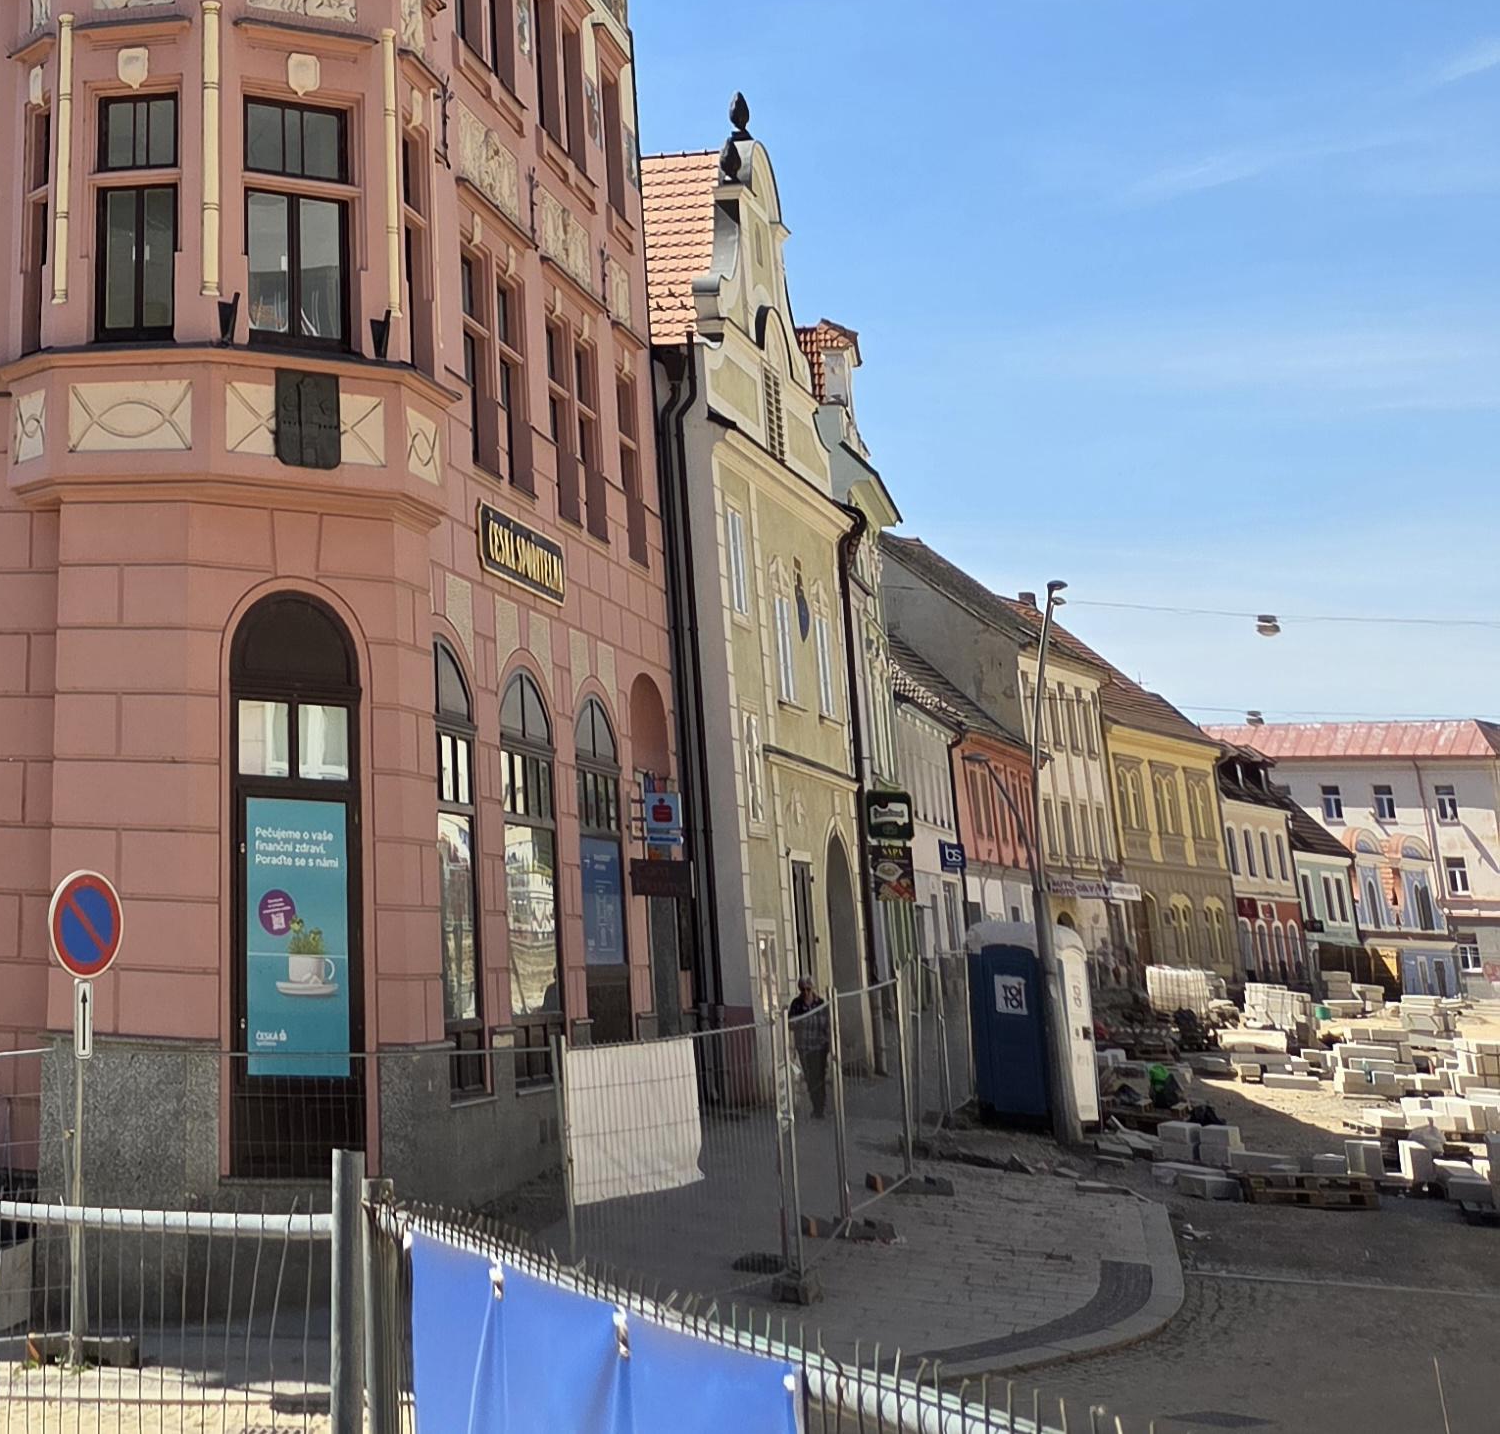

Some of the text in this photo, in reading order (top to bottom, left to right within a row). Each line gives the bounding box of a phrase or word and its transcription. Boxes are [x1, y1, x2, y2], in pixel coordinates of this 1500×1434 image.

[488, 509, 517, 571] ČESKÁ
[255, 826, 334, 841] Pečujeme o vaše
[255, 840, 326, 854] finanční zdraví.
[255, 853, 339, 868] Poraďte se s námi
